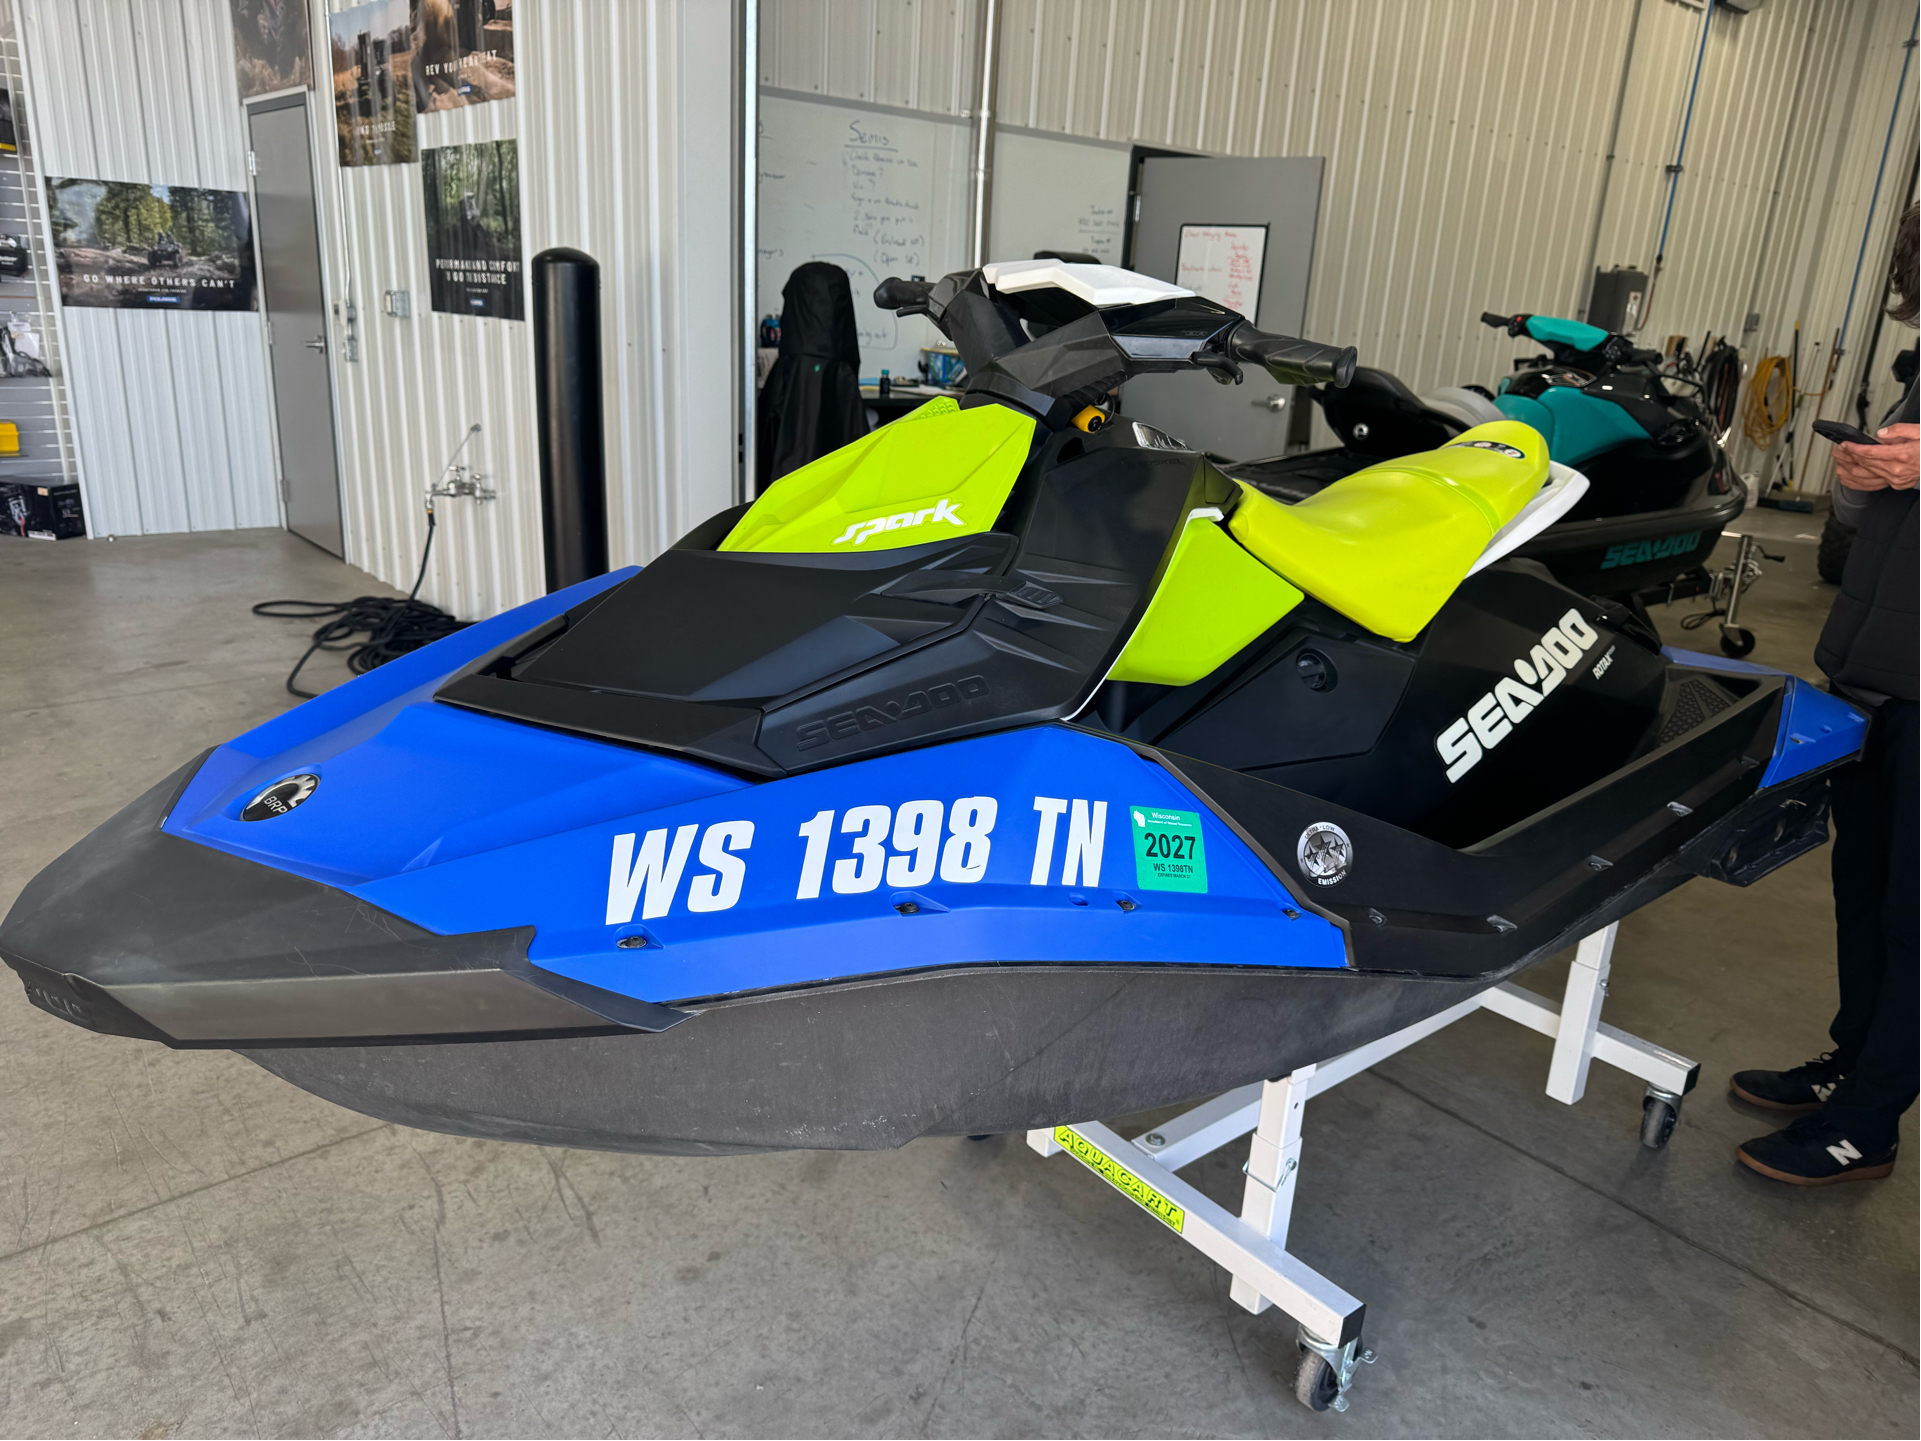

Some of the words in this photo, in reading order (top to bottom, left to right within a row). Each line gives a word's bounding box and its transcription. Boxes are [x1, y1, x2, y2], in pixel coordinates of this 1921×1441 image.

[425, 64, 440, 76] REV
[83, 274, 99, 283] GO
[105, 275, 145, 285] WHERE
[151, 276, 196, 287] OTHERS
[201, 279, 235, 288] CAN'T
[833, 498, 964, 545] spark
[264, 796, 288, 813] BRP
[1151, 812, 1180, 821] Wisconsin
[1144, 832, 1196, 860] 2027
[605, 820, 755, 925] WS
[796, 796, 998, 899] 1398
[1030, 796, 1108, 887] TN
[1153, 863, 1166, 871] WS
[1168, 864, 1193, 873] 1398TN
[1317, 869, 1346, 886] EMISSION
[1825, 1139, 1863, 1167] N
[1059, 1129, 1177, 1217] AQUACART
